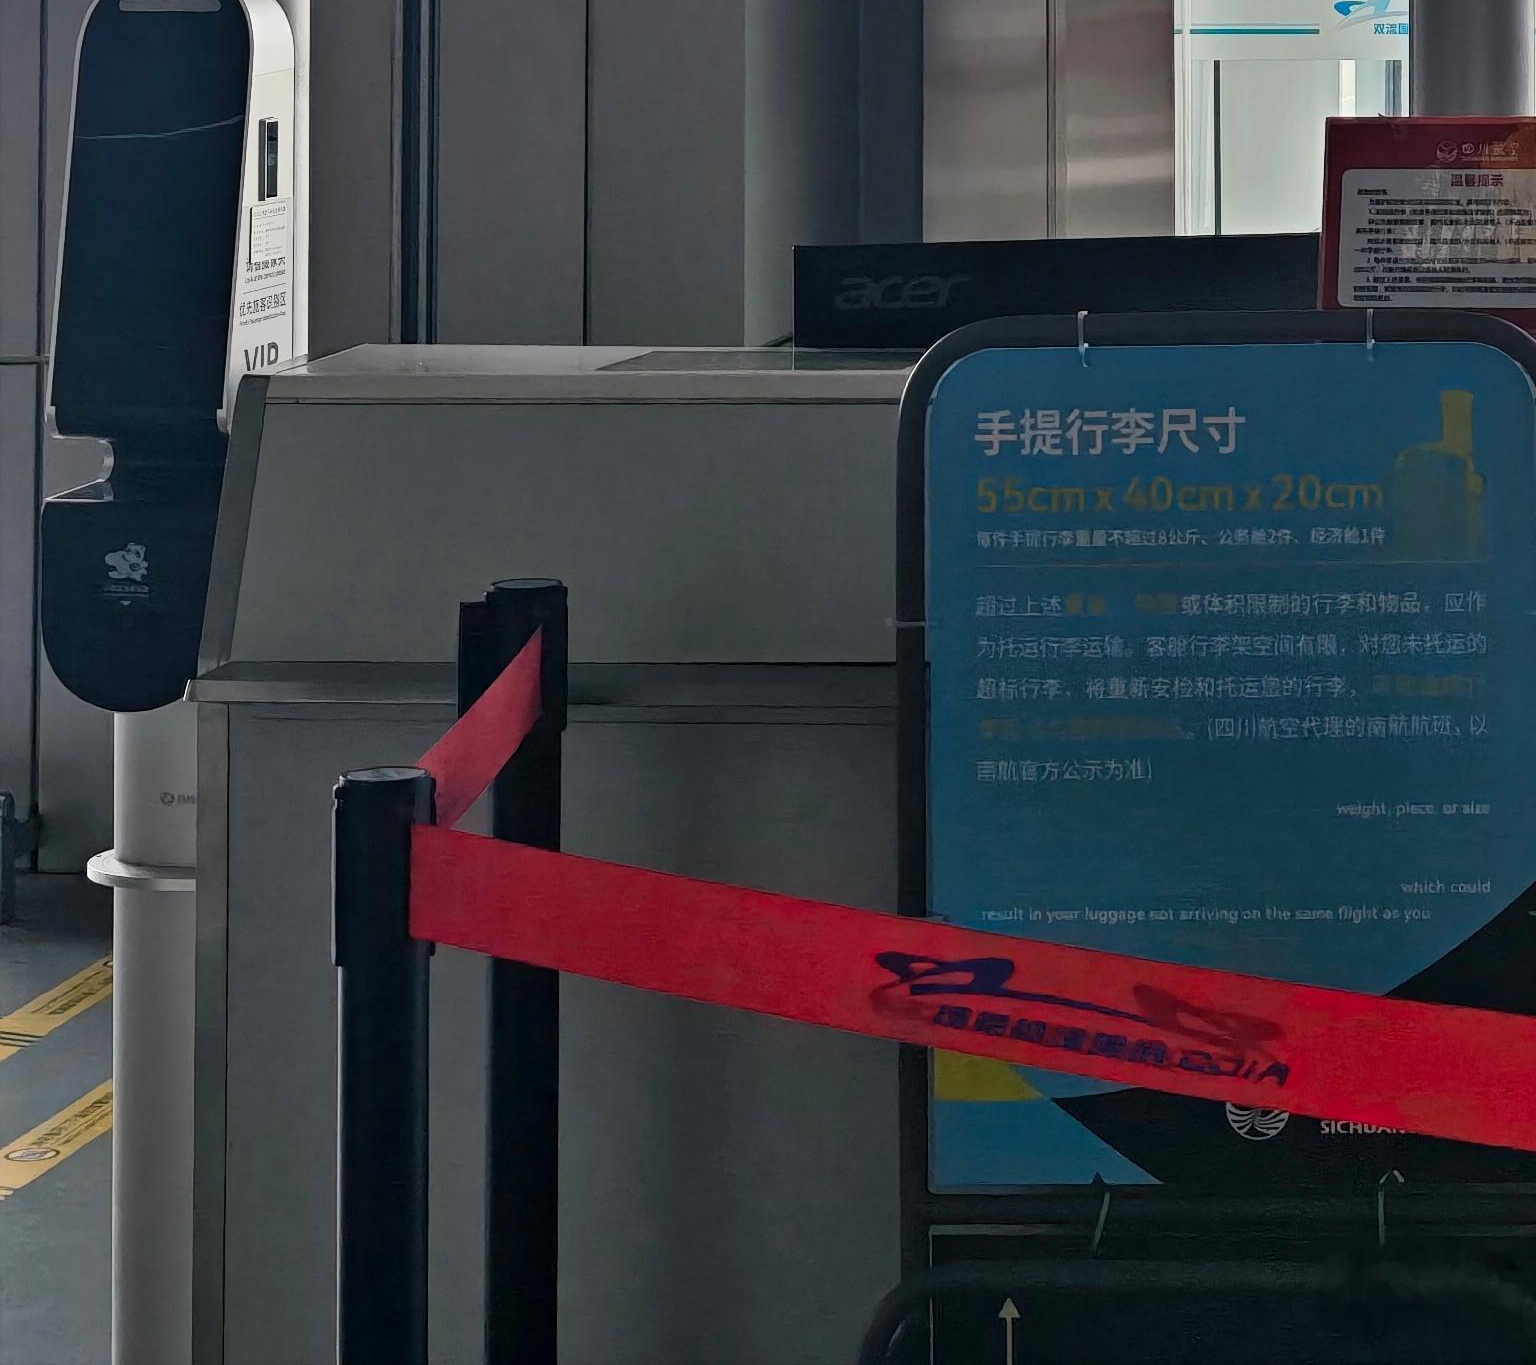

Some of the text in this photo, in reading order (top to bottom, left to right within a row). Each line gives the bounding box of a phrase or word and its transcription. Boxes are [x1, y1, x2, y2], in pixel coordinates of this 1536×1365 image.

[833, 272, 971, 310] acer
[973, 406, 1247, 458] 手提行李尺寸
[976, 477, 1086, 515] 55cm
[1123, 475, 1236, 514] 40cm
[1272, 473, 1384, 511] 20cm
[1400, 879, 1491, 894] which could
[981, 906, 1023, 921] result
[1029, 906, 1041, 921] in
[1046, 909, 1080, 924] your
[1084, 906, 1146, 924] luggage
[1242, 909, 1261, 921] on
[1337, 905, 1379, 924] flight
[1382, 910, 1400, 921] as
[1320, 1119, 1404, 1135] SICHU
